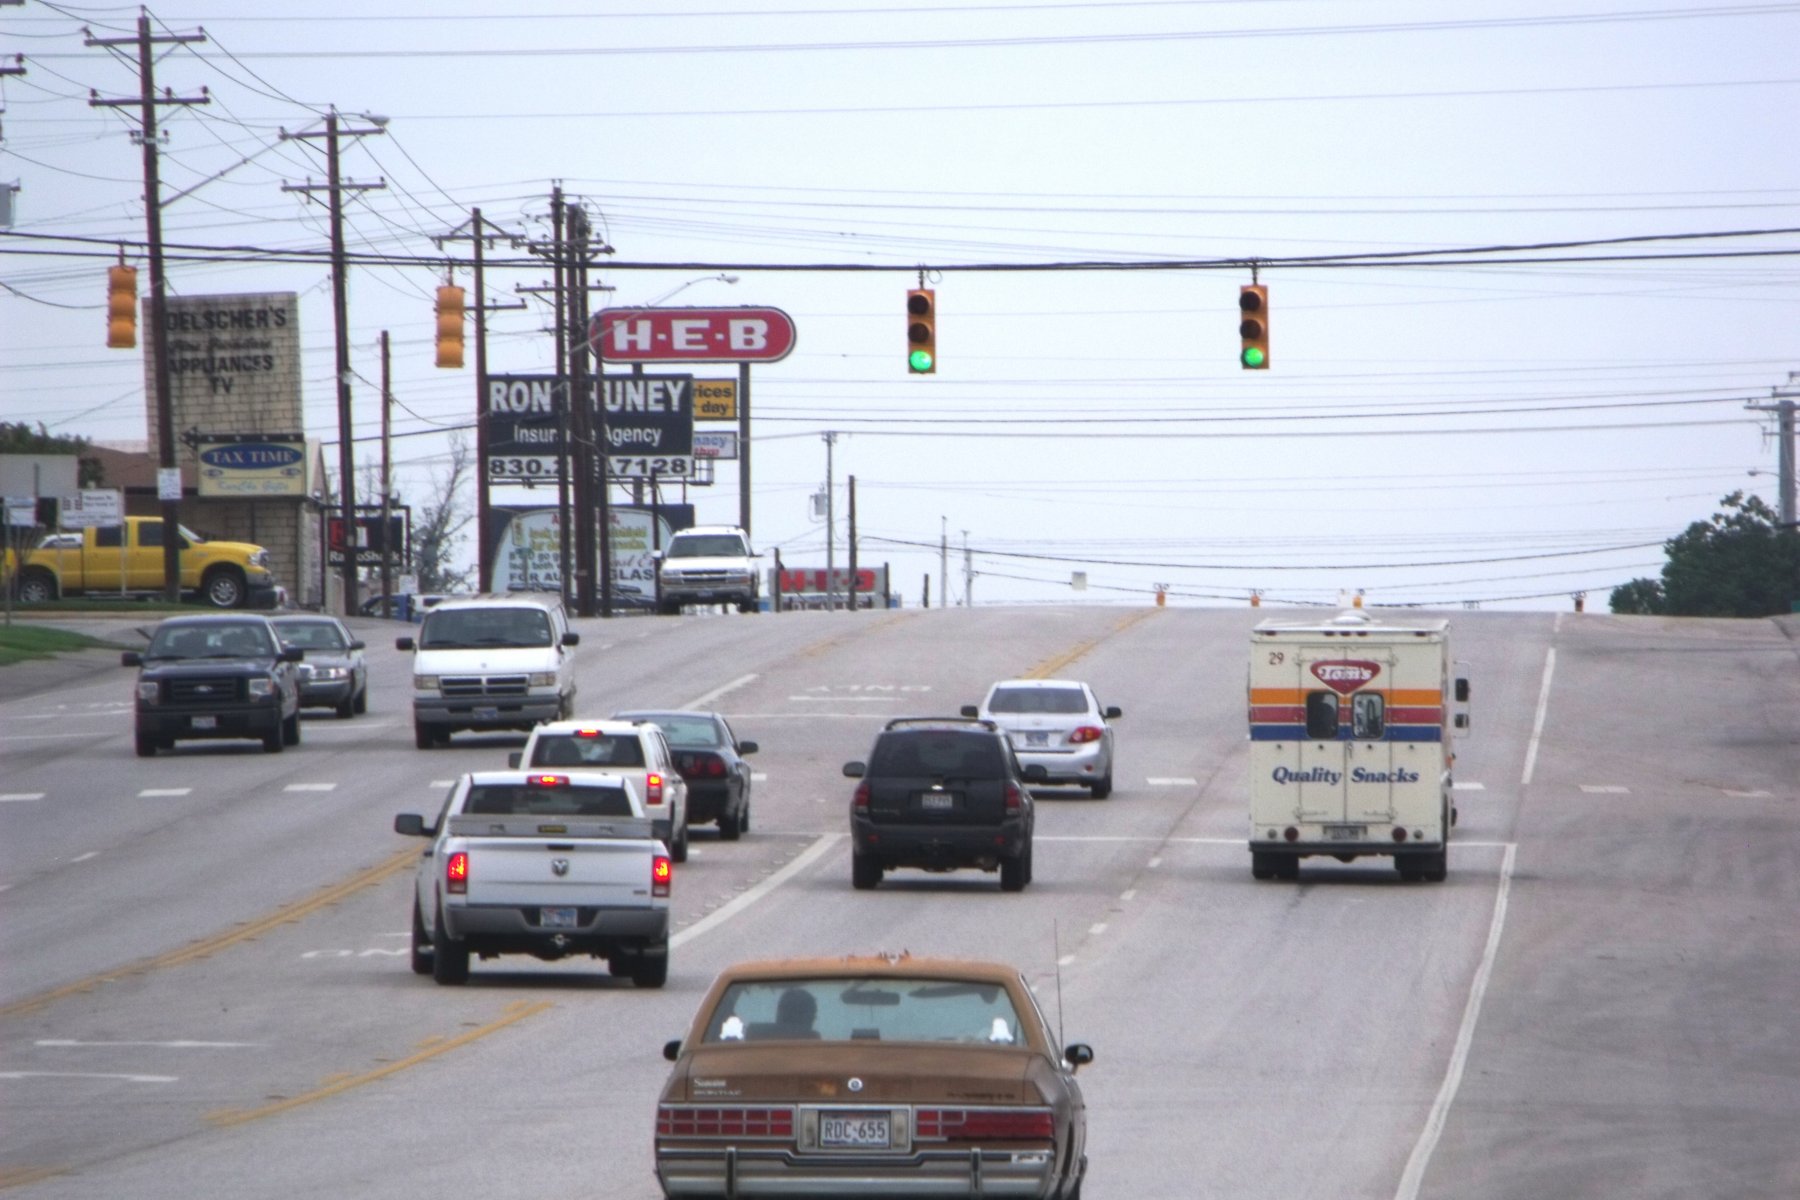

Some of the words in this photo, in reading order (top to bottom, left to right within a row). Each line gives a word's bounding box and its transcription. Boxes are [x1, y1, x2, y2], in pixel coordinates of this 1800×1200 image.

[209, 375, 234, 394] TV
[489, 380, 553, 413] RON
[701, 401, 728, 415] day
[210, 450, 246, 464] TAX
[248, 449, 295, 463] TIME
[1268, 651, 1285, 666] 29
[1317, 664, 1373, 681] Tom's
[1272, 766, 1342, 786] Quality
[1351, 766, 1420, 783] Snacks
